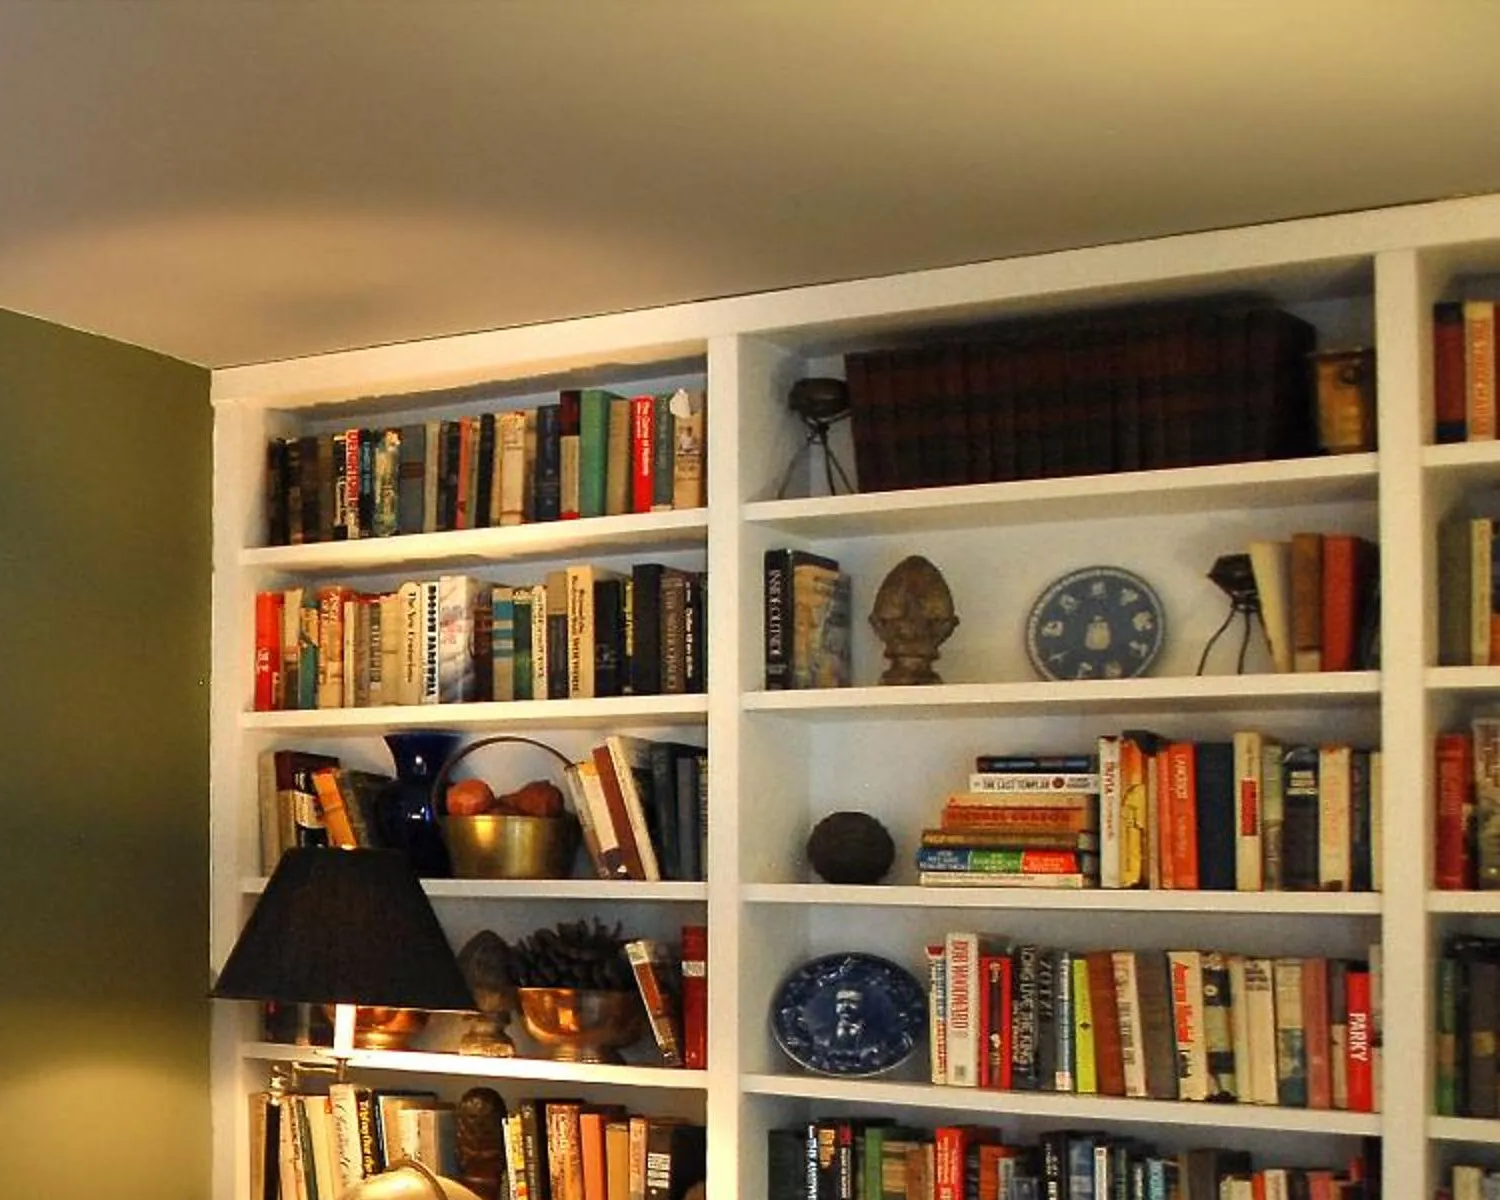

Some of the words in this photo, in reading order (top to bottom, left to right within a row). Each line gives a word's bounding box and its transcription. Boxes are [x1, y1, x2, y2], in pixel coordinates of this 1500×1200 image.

[407, 592, 417, 608] The
[952, 941, 969, 962] BOB
[1021, 947, 1036, 982] LONG
[951, 965, 969, 1030] WOODWARD
[1020, 983, 1035, 1009] LIVE
[1018, 1035, 1035, 1064] KING
[1349, 1013, 1368, 1061] PARKY
